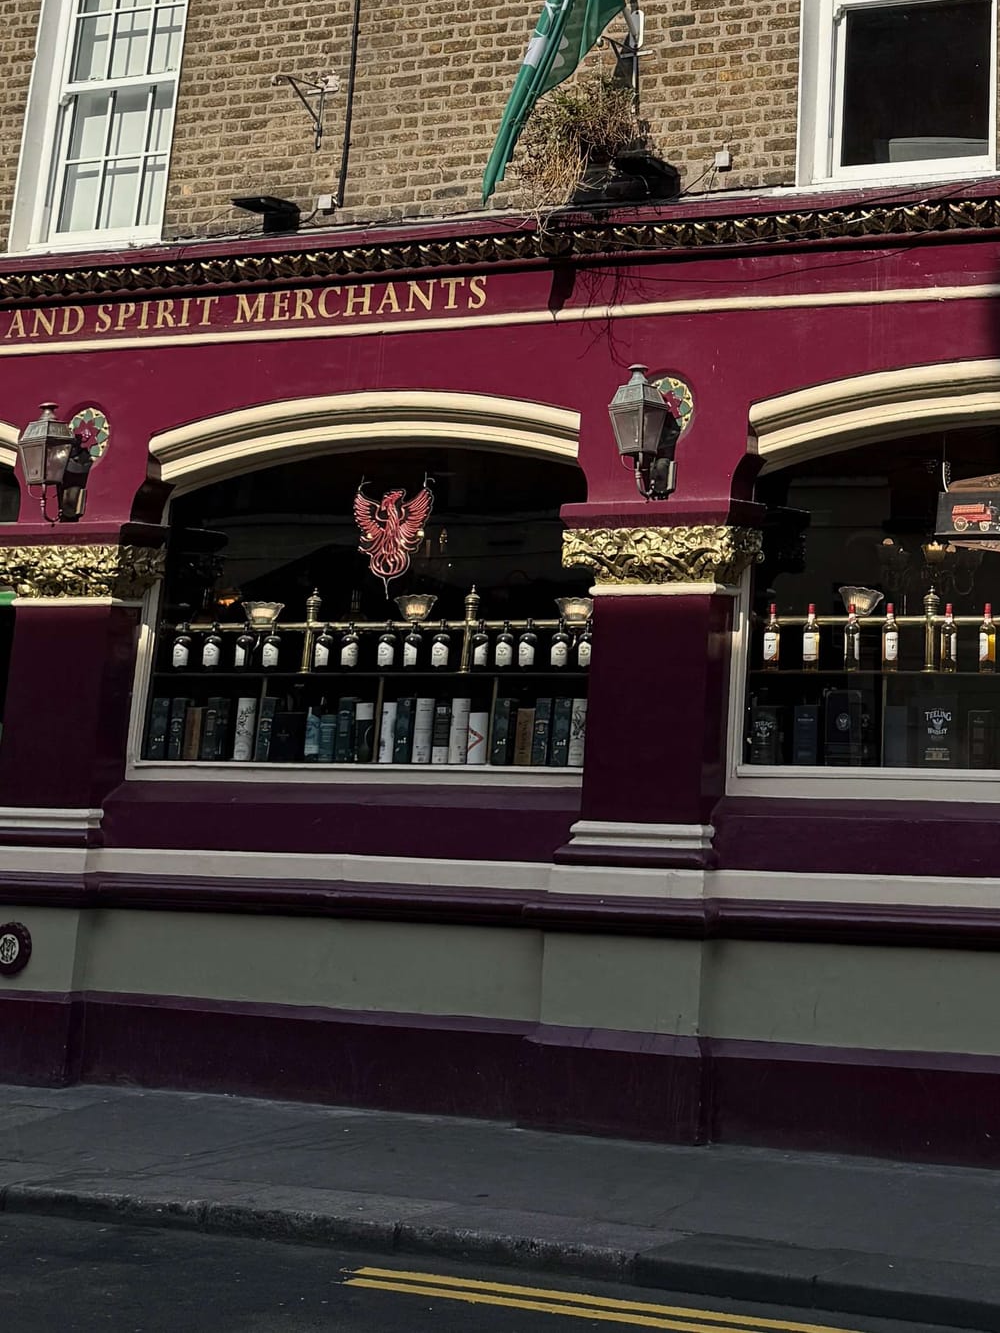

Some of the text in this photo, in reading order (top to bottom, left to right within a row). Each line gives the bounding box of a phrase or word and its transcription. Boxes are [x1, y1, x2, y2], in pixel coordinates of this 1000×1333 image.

[5, 275, 488, 338] AND SPIRIT MERCHANTS
